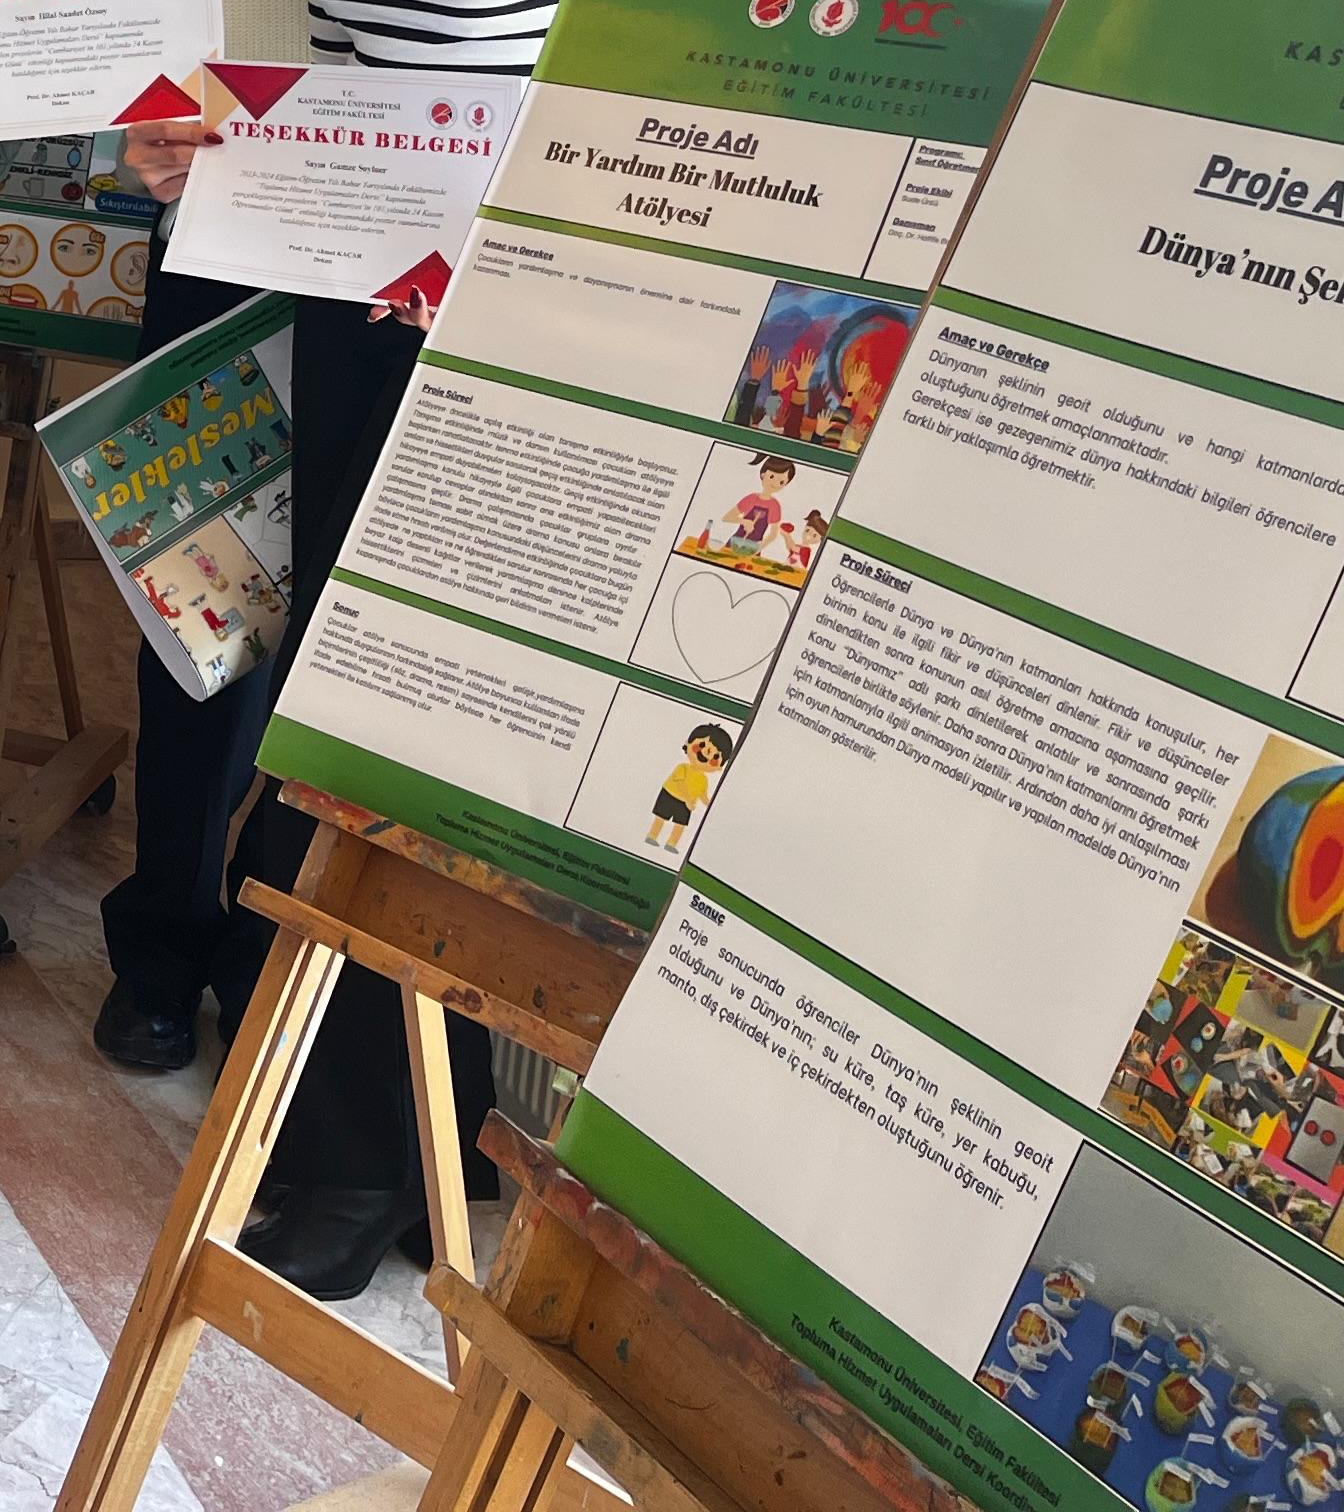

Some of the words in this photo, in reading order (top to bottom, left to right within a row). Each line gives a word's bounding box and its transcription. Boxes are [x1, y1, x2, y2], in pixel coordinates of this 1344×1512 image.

[685, 50, 816, 78] KASTAMONU
[828, 66, 991, 101] ÜNİVERSİTESİ
[722, 78, 796, 100] EĞİTİM
[807, 90, 928, 118] FAKÜLTESİ
[229, 121, 365, 147] TEŞEKKÜR
[375, 132, 492, 157] BELGESİ
[635, 117, 710, 153] Proje
[707, 129, 760, 161] Adı
[544, 140, 581, 165] Bir
[584, 147, 666, 181] Yardım
[667, 161, 708, 187] Bir
[708, 169, 823, 208] Mutluluk
[1194, 154, 1309, 211] Proje
[615, 192, 713, 228] Atölyesi
[1137, 225, 1296, 291] Dünya'nın
[937, 326, 978, 352] Amaç
[972, 340, 995, 357] ve
[990, 343, 1050, 374] Gerekçe
[920, 370, 991, 403] oluştuğunu
[990, 392, 1051, 424] öğretmek
[1051, 415, 1169, 465] amaçlanmaktadır.
[928, 349, 988, 379] Dünyanın
[997, 374, 1046, 398] şeklinin
[1056, 393, 1092, 413] geoit
[1102, 407, 1166, 437] olduğunu
[1177, 432, 1194, 447] ve
[1205, 438, 1247, 465] hangi
[902, 408, 936, 431] farklı
[935, 420, 955, 437] bir
[951, 429, 1020, 461] yaklaşımla
[1020, 451, 1096, 489] öğretmektir.
[911, 389, 974, 421] Gerekçesi
[974, 411, 993, 428] ise
[997, 421, 1077, 458] gezegenimiz
[1079, 448, 1122, 473] dünya
[1125, 462, 1199, 499] hakkındaki
[1200, 487, 1253, 517] bilgileri
[1255, 506, 1337, 547] öğrencilere
[839, 552, 874, 580] Proje
[869, 567, 914, 595] Süreci
[831, 573, 896, 613] Öğrencilerle
[899, 605, 935, 631] Dünya
[940, 625, 955, 639] ve
[958, 631, 1015, 667] Dünya'nın
[1018, 658, 1083, 696] katmanları
[1086, 688, 1141, 722] hakkında
[1144, 713, 1207, 755] konuşulur,
[1215, 745, 1240, 766] her
[777, 701, 832, 738] katmanları
[830, 731, 878, 762] gösterilir.
[815, 612, 881, 651] dinlendikten
[884, 645, 915, 666] sonra
[918, 658, 966, 691] konunun
[970, 685, 992, 702] asıl
[995, 694, 1045, 727] öğretme
[1049, 721, 1100, 753] amacına
[1104, 747, 1170, 785] aşamasına
[1174, 780, 1217, 809] geçilir.
[688, 894, 726, 927] Sonuç
[668, 943, 725, 987] olduğunu
[730, 982, 745, 1001] ve
[749, 994, 817, 1051] Dünya'nın;
[821, 1045, 840, 1064] su
[843, 1055, 875, 1092] küre,
[884, 1083, 908, 1114] taş
[913, 1101, 946, 1139] küre,
[951, 1132, 979, 1155] yer
[982, 1148, 1038, 1201] kabuğu,
[678, 918, 709, 947] Proje
[717, 947, 786, 998] sonucunda
[795, 994, 861, 1046] öğrenciler
[870, 1043, 939, 1098] Dünya'nın
[950, 1097, 1002, 1140] şeklinin
[1014, 1140, 1054, 1174] geoit
[657, 965, 697, 1002] manto,
[699, 993, 719, 1017] dış
[718, 1007, 771, 1049] çekirdek
[771, 1041, 787, 1059] ve
[786, 1049, 801, 1072] iç
[799, 1062, 876, 1121] çekirdekten
[876, 1114, 954, 1173] oluştuğunu
[954, 1162, 1004, 1210] öğrenir.
[790, 1312, 837, 1361] Topluma
[828, 1316, 894, 1375] Kastamonu
[965, 1423, 1005, 1463] Eğitim
